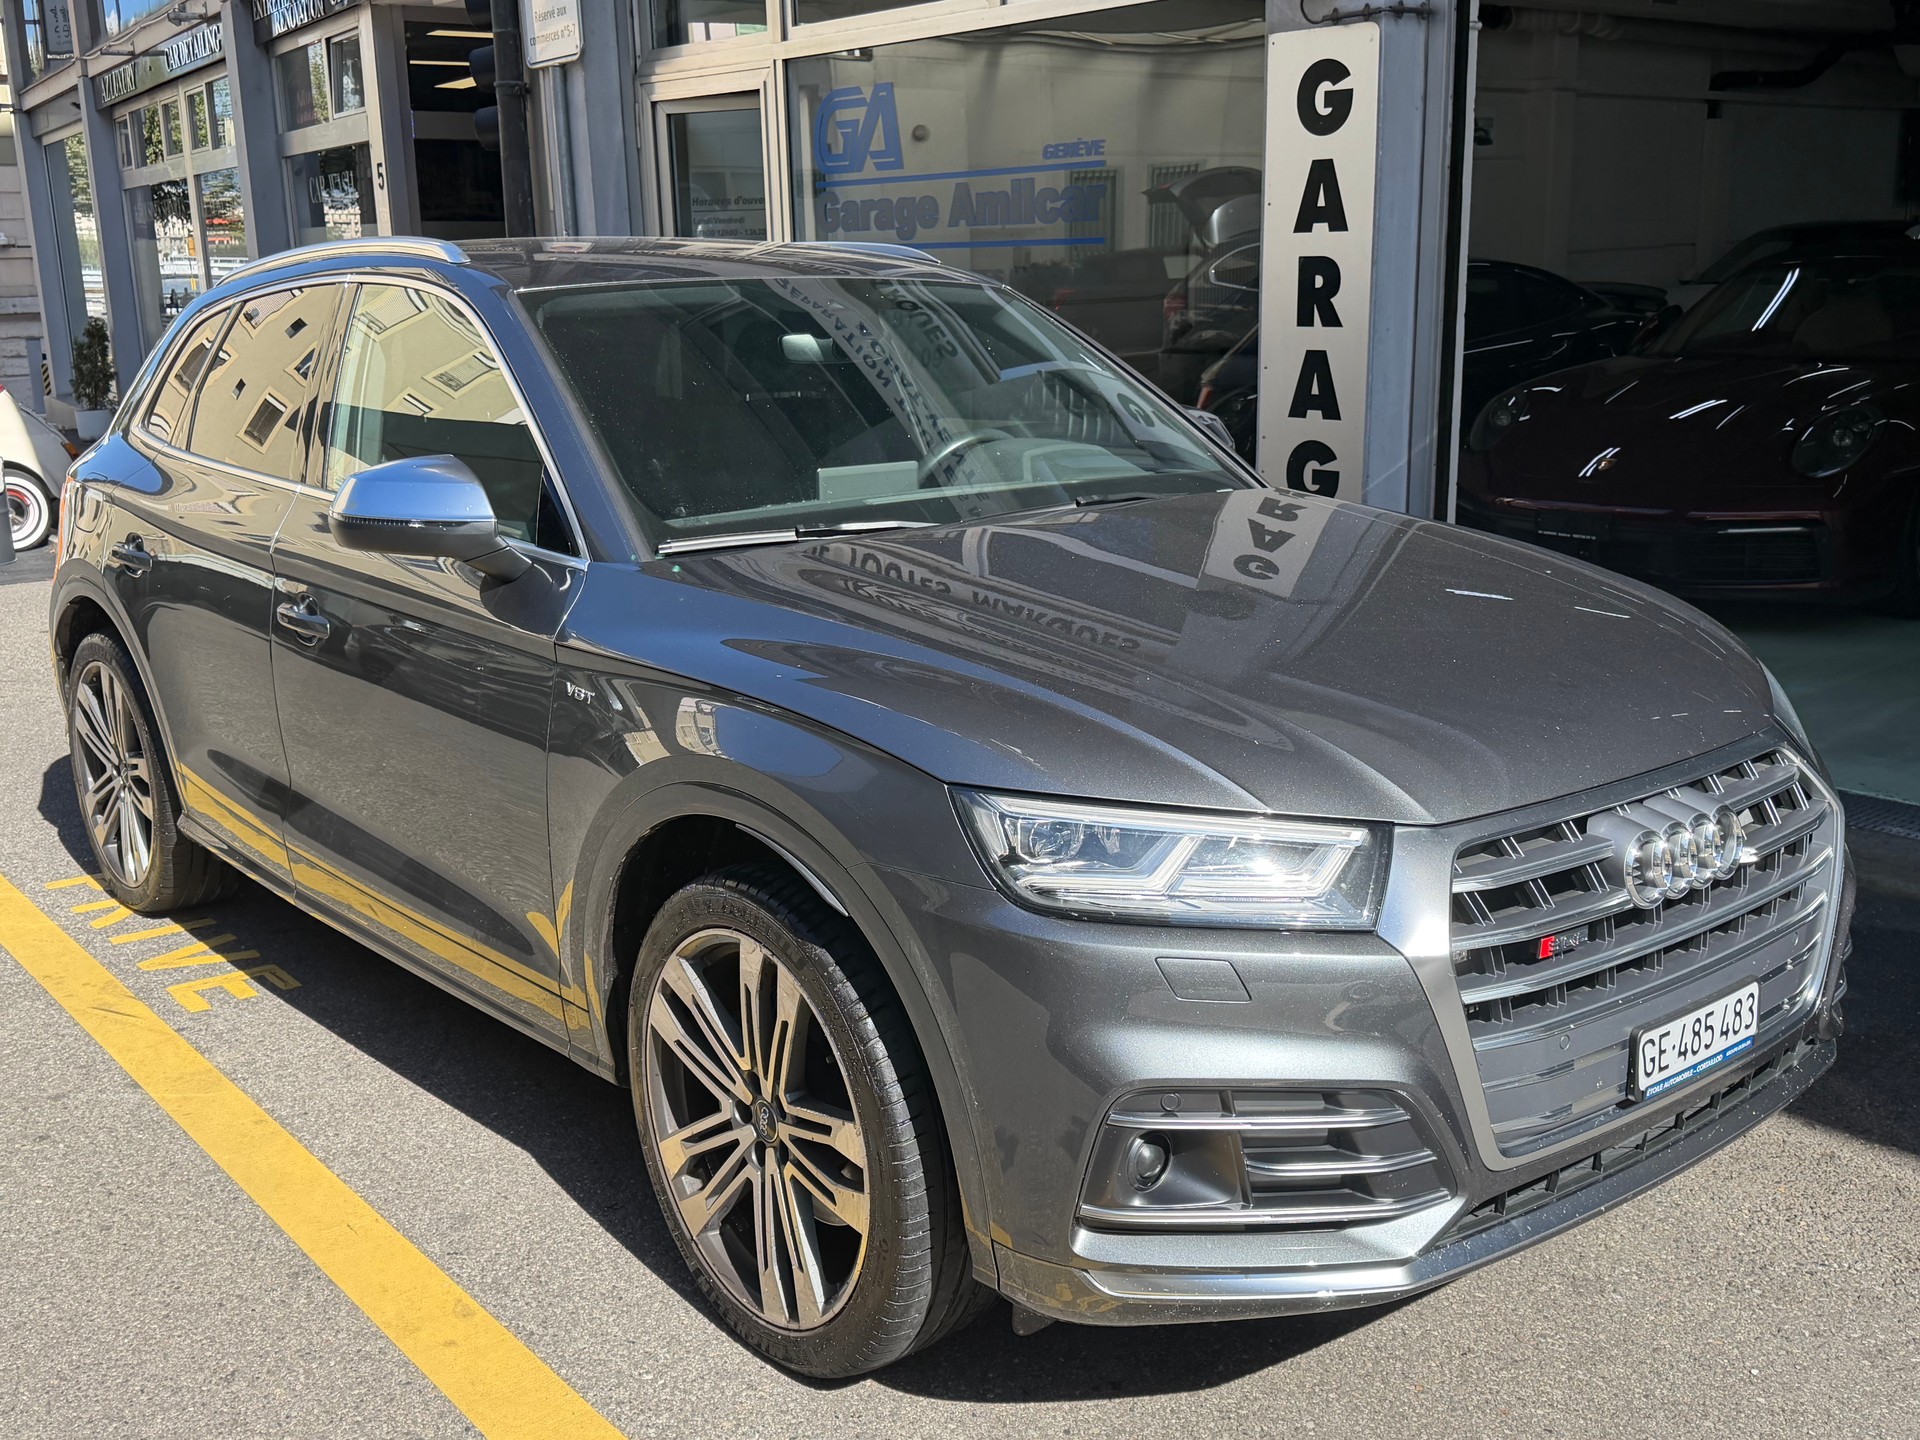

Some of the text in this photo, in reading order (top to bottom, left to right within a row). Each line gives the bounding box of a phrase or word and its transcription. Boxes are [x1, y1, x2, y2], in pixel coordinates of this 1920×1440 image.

[534, 6, 567, 23] Réservé aux
[529, 30, 560, 46] commerces
[1042, 137, 1107, 160] GENÈVE
[376, 162, 385, 191] 5
[816, 191, 940, 241] Garage
[566, 681, 596, 704] V6T
